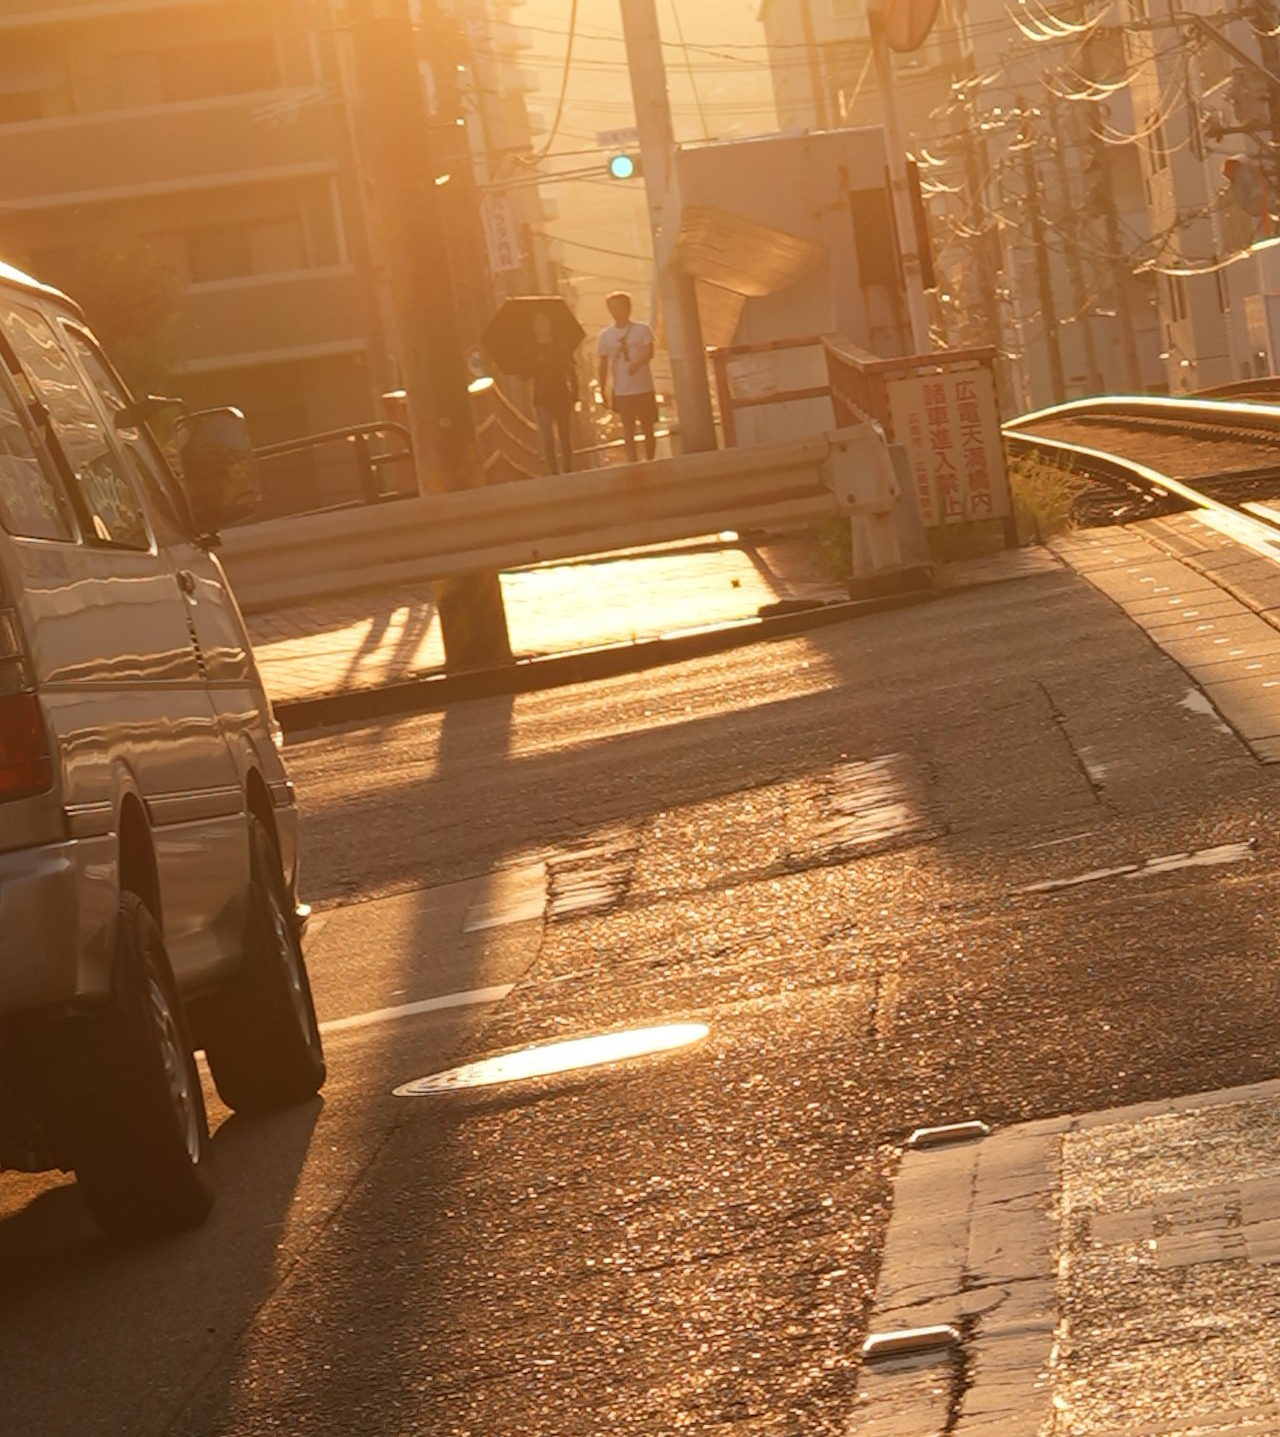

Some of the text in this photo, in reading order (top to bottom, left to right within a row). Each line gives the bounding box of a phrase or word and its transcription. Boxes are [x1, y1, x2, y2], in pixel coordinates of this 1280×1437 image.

[923, 383, 963, 517] 諸車進入禁止
[955, 380, 992, 513] 広電天満橋内
